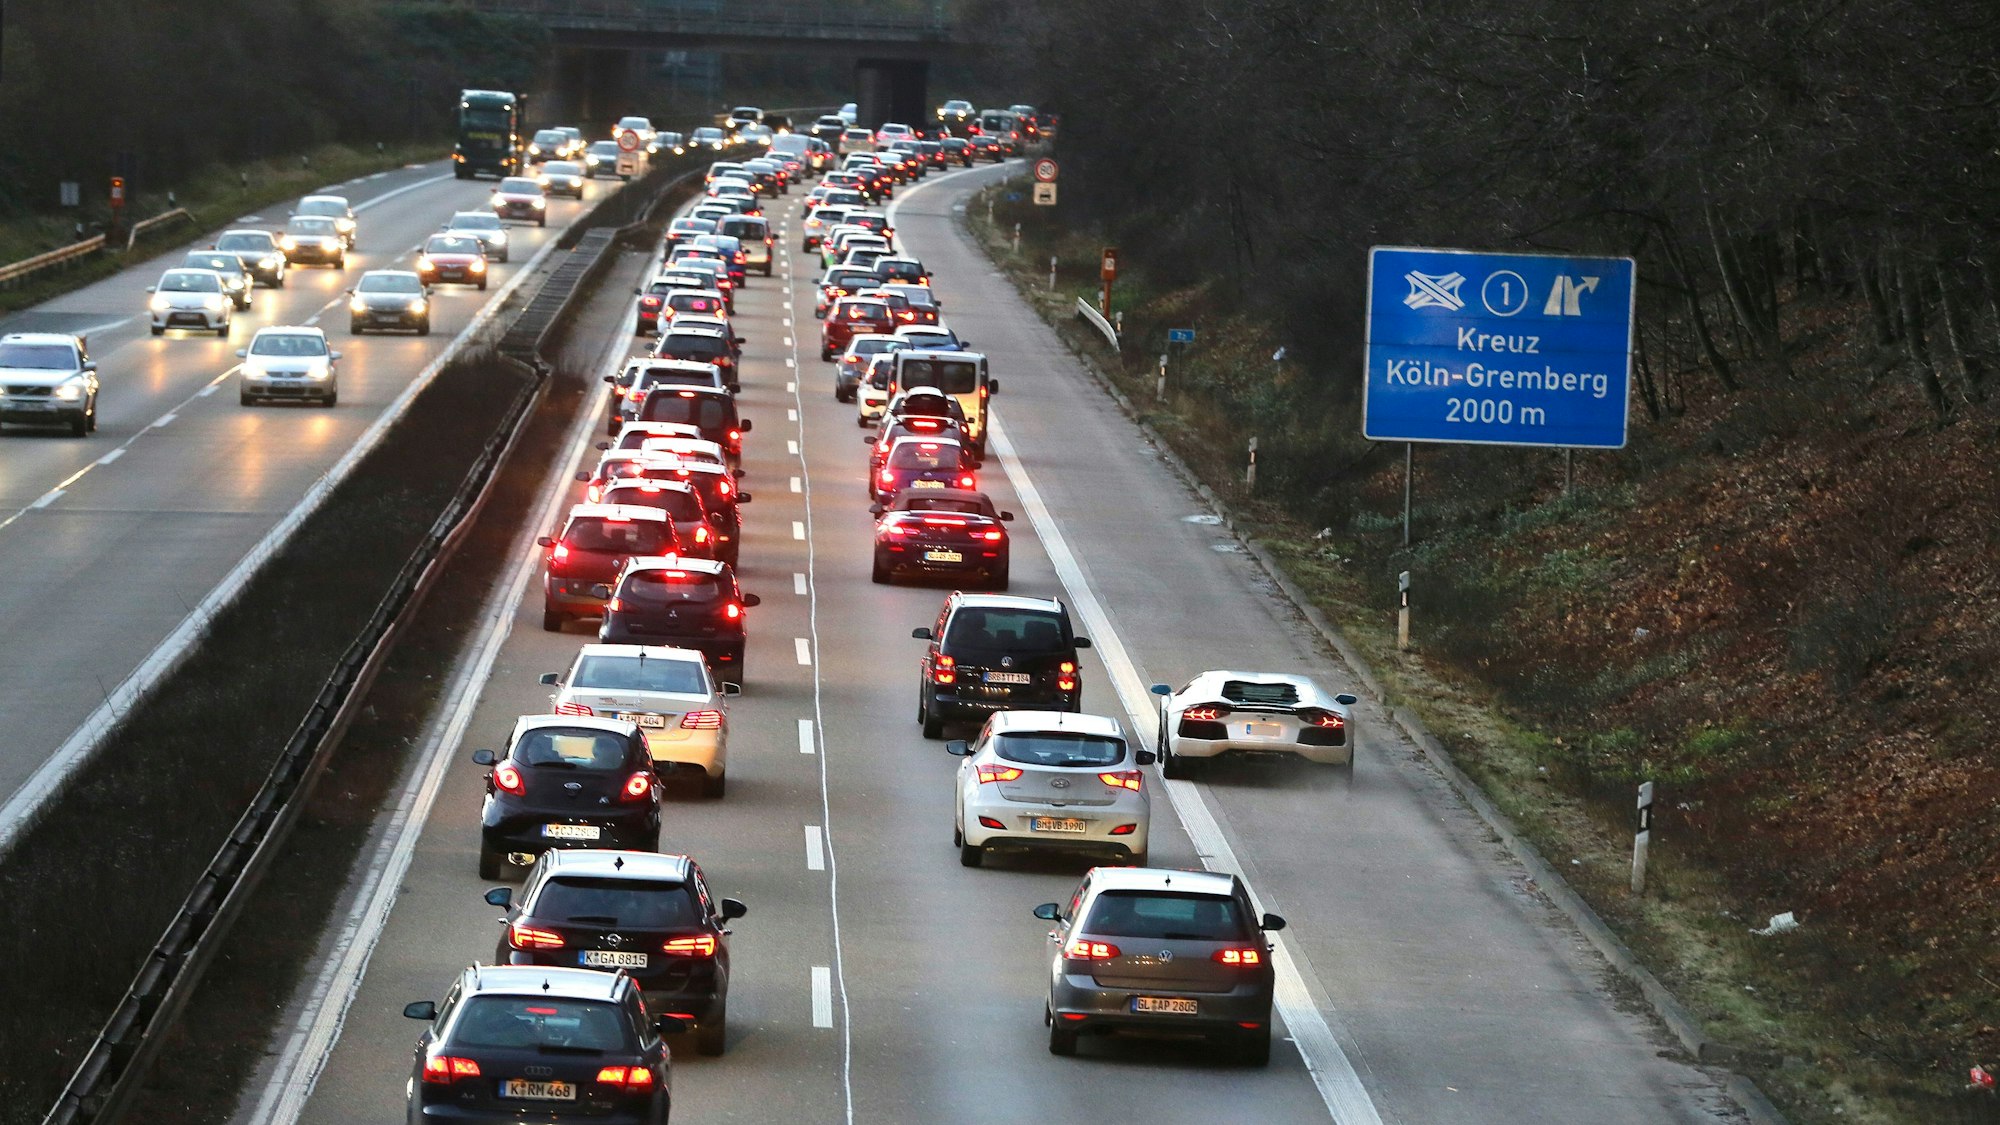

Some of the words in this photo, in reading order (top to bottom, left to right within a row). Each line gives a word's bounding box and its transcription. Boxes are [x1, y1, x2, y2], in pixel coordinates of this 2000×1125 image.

[1040, 164, 1053, 176] 80
[1500, 281, 1510, 306] 1
[1457, 326, 1540, 354] Kreuz
[1386, 358, 1608, 399] Köln-Gremberg
[1446, 397, 1513, 425] 2000
[1520, 406, 1546, 426] m
[643, 716, 660, 725] 404
[1063, 821, 1084, 831] 1990
[600, 953, 615, 965] GA
[617, 953, 647, 967] 8815
[1138, 999, 1150, 1010] GL
[1157, 1000, 1170, 1011] AP
[1172, 1000, 1197, 1013] 2805
[510, 1083, 519, 1096] K
[527, 1083, 545, 1097] RM
[546, 1084, 571, 1098] 468
